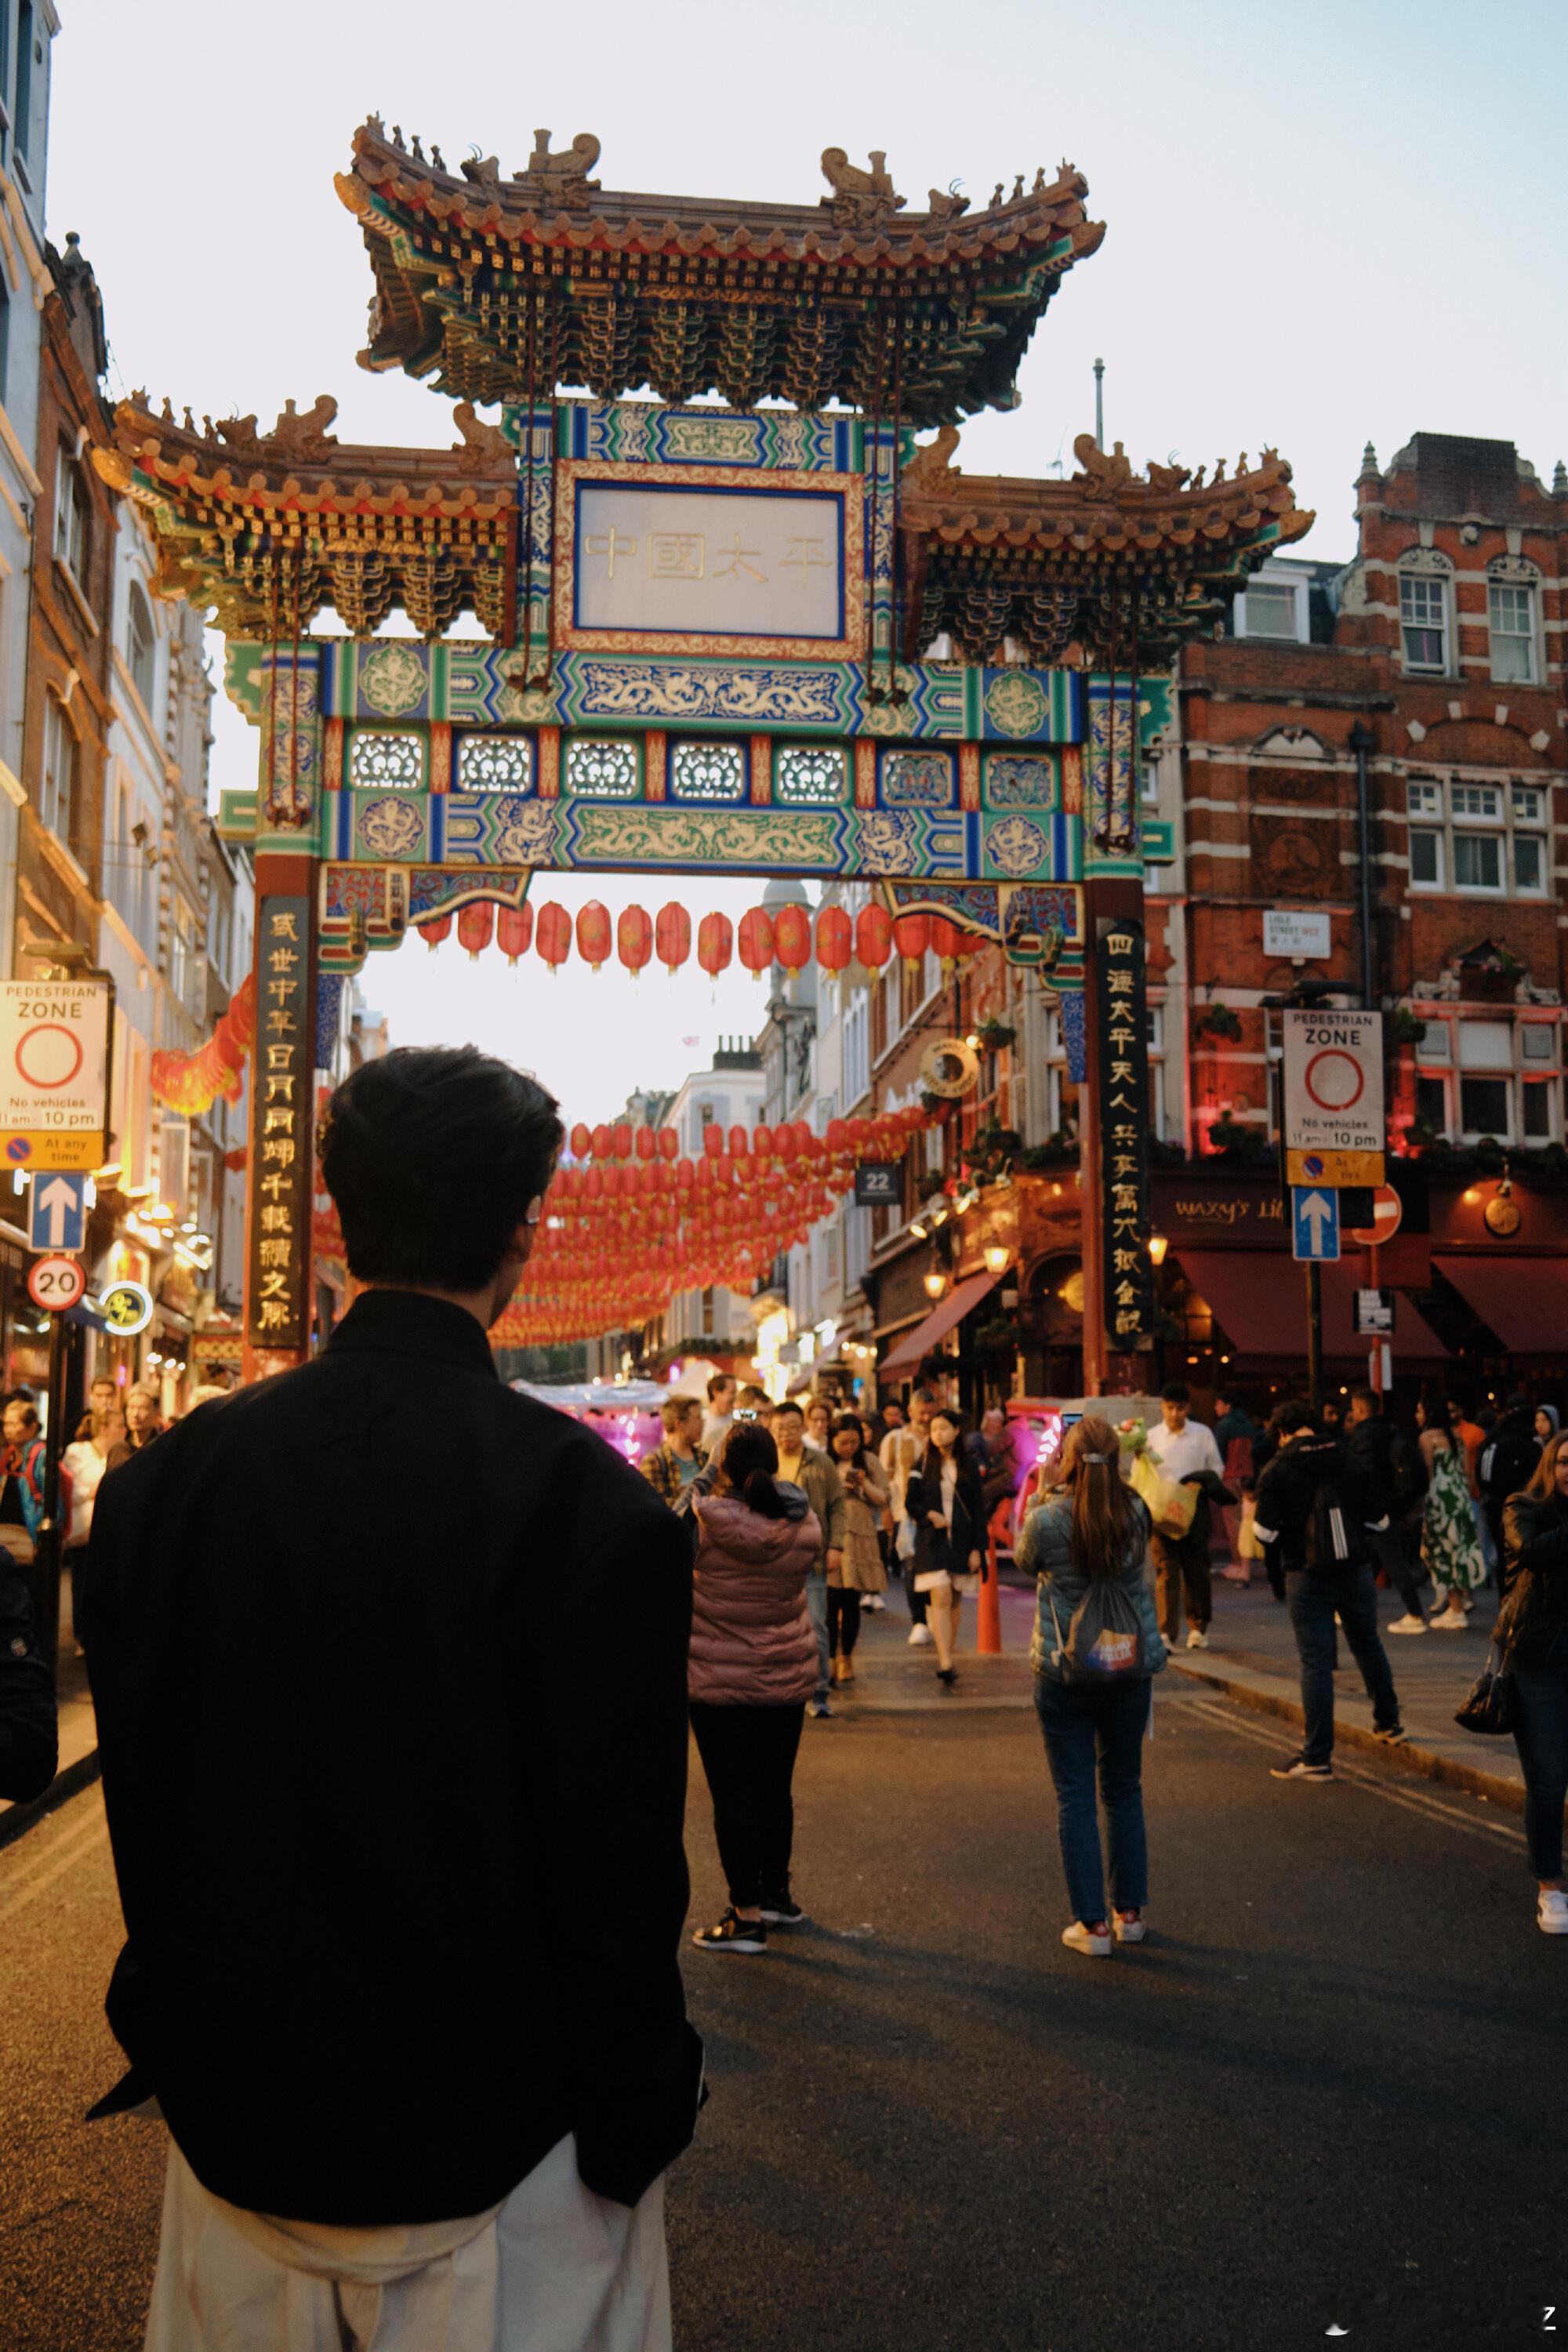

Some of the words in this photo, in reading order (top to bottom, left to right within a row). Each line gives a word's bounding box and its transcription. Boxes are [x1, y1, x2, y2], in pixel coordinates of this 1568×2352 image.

[584, 524, 833, 588] 中國太平
[6, 985, 96, 997] PEDESTRIAN
[18, 1002, 82, 1018] ZONE
[1294, 1013, 1372, 1025] PEDESTRIAN
[1305, 1029, 1360, 1045] ZONE
[10, 1098, 28, 1107] No
[33, 1098, 85, 1108] vehicles
[45, 1111, 64, 1124] 10
[69, 1114, 94, 1126] pm
[1302, 1118, 1318, 1128] No
[1323, 1120, 1368, 1129] vehicles
[45, 1138, 59, 1149] At
[65, 1140, 87, 1151] any
[1334, 1132, 1350, 1145] 10
[1355, 1135, 1377, 1147] pm
[51, 1152, 80, 1161] time
[866, 1172, 889, 1190] 22
[39, 1272, 75, 1293] 20
